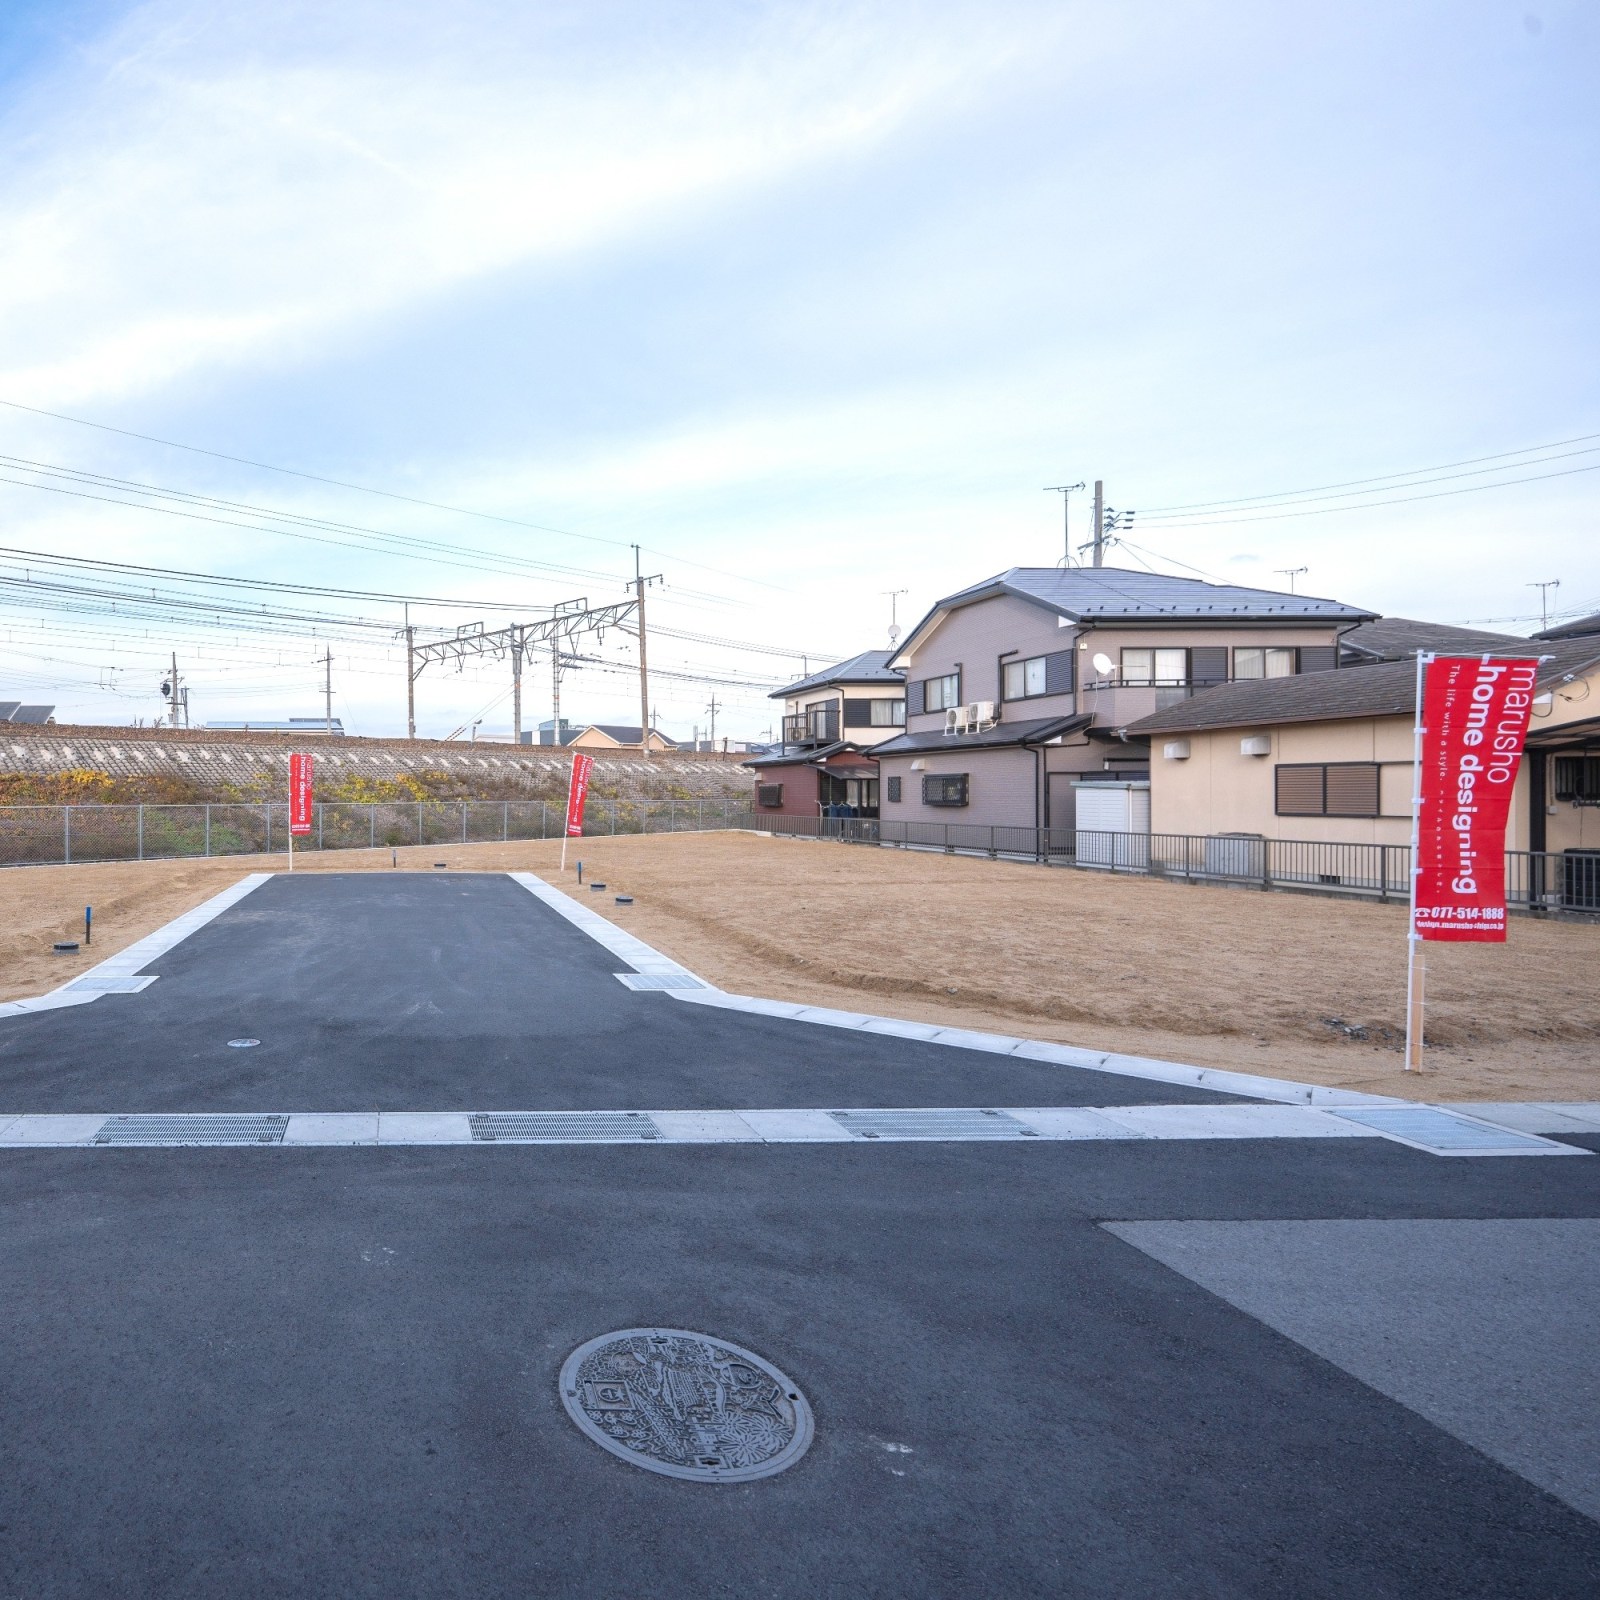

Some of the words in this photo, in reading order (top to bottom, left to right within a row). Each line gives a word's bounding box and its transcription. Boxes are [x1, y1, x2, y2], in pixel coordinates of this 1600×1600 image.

[1448, 664, 1461, 685] The
[1445, 689, 1456, 707] life
[1463, 666, 1507, 747] home
[1441, 711, 1451, 736] with
[1487, 667, 1536, 784] marusho
[1438, 751, 1448, 781] style.
[1451, 754, 1484, 894] designing
[1431, 906, 1504, 919] 077-514-1888
